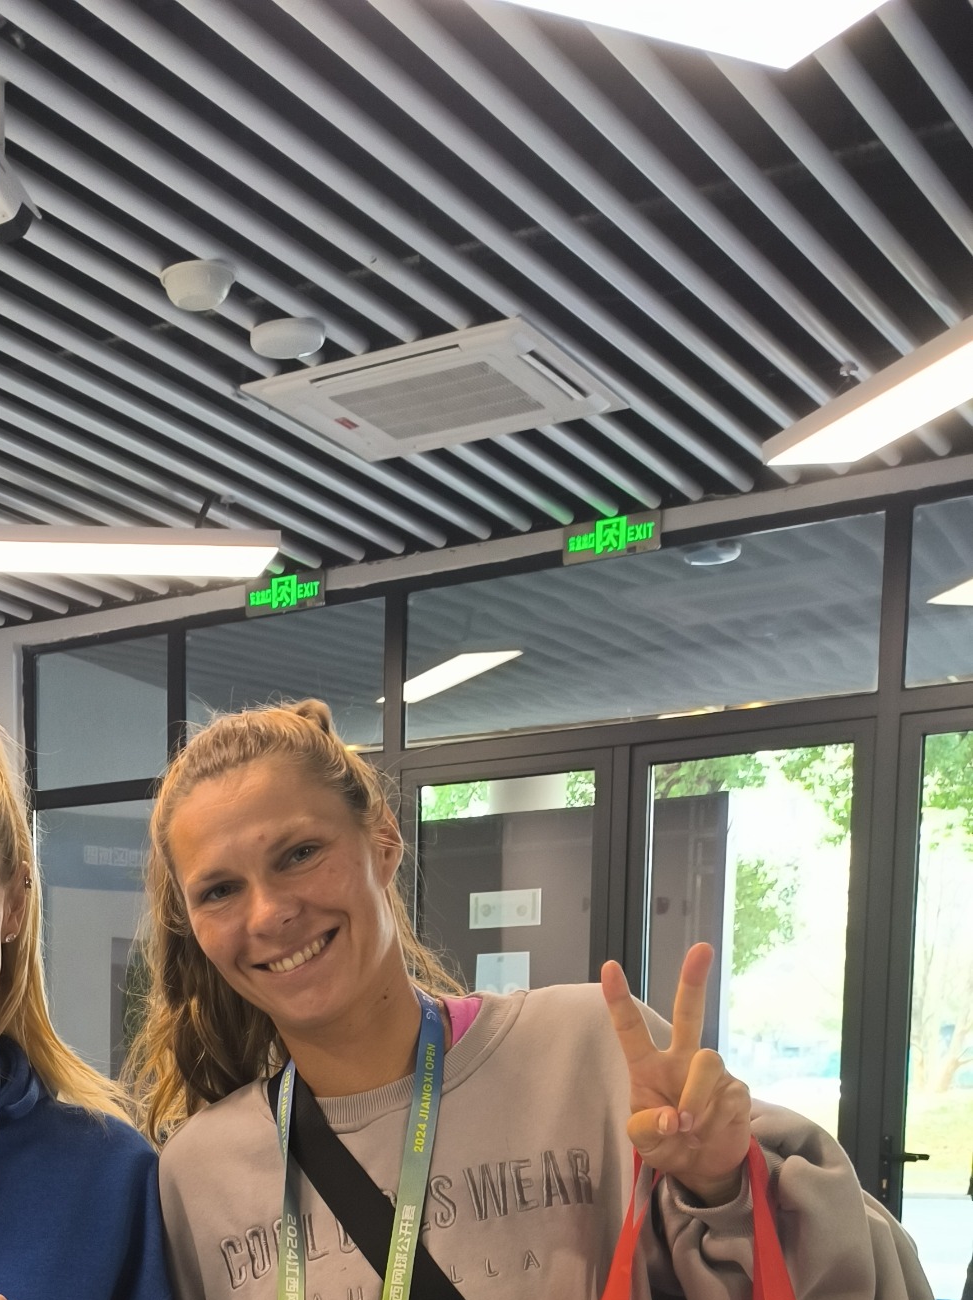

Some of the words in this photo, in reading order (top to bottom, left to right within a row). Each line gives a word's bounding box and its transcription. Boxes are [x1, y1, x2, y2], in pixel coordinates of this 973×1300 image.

[627, 522, 655, 542] EXIT
[297, 581, 320, 599] EXIT
[426, 1043, 436, 1070] OPEN
[418, 1072, 434, 1121] JIANGXI
[414, 1123, 427, 1153] 2024
[463, 1148, 594, 1222] WEAR
